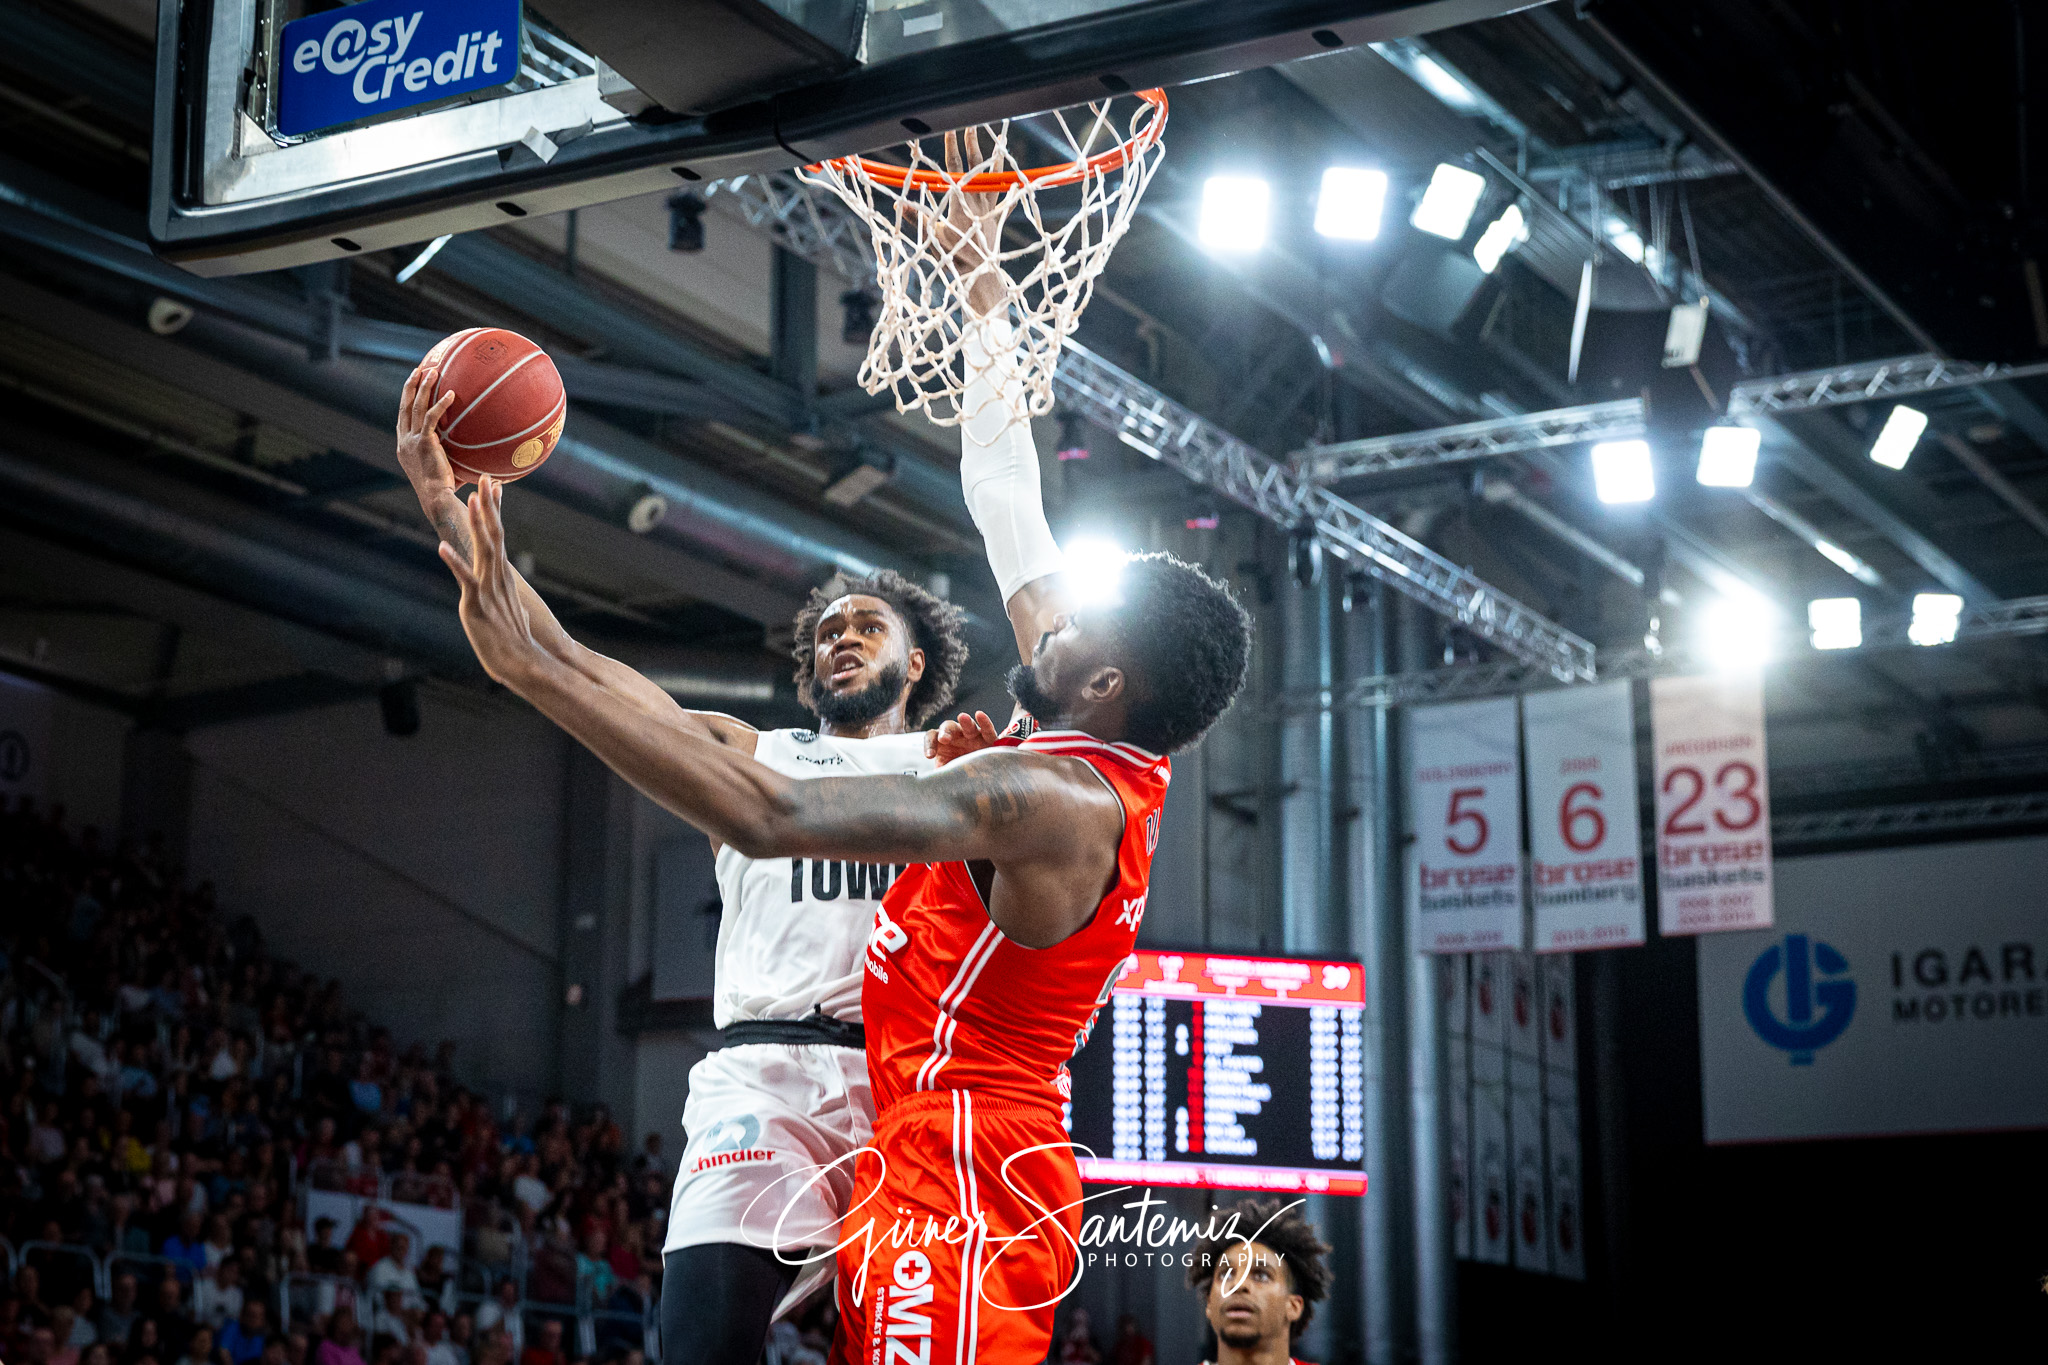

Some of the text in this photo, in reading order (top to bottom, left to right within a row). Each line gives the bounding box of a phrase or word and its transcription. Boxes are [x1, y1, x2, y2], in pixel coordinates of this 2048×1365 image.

[293, 11, 424, 75] e@sy
[353, 30, 503, 104] Credit
[1557, 780, 1607, 853] 6
[1662, 760, 1762, 836] 23
[1446, 787, 1490, 857] 5
[1420, 862, 1516, 890] brose
[1535, 857, 1638, 887] brose
[1662, 840, 1764, 867] brose
[1115, 886, 1149, 932] xp
[1890, 942, 2048, 988] IGAR
[690, 1148, 776, 1174] hindler
